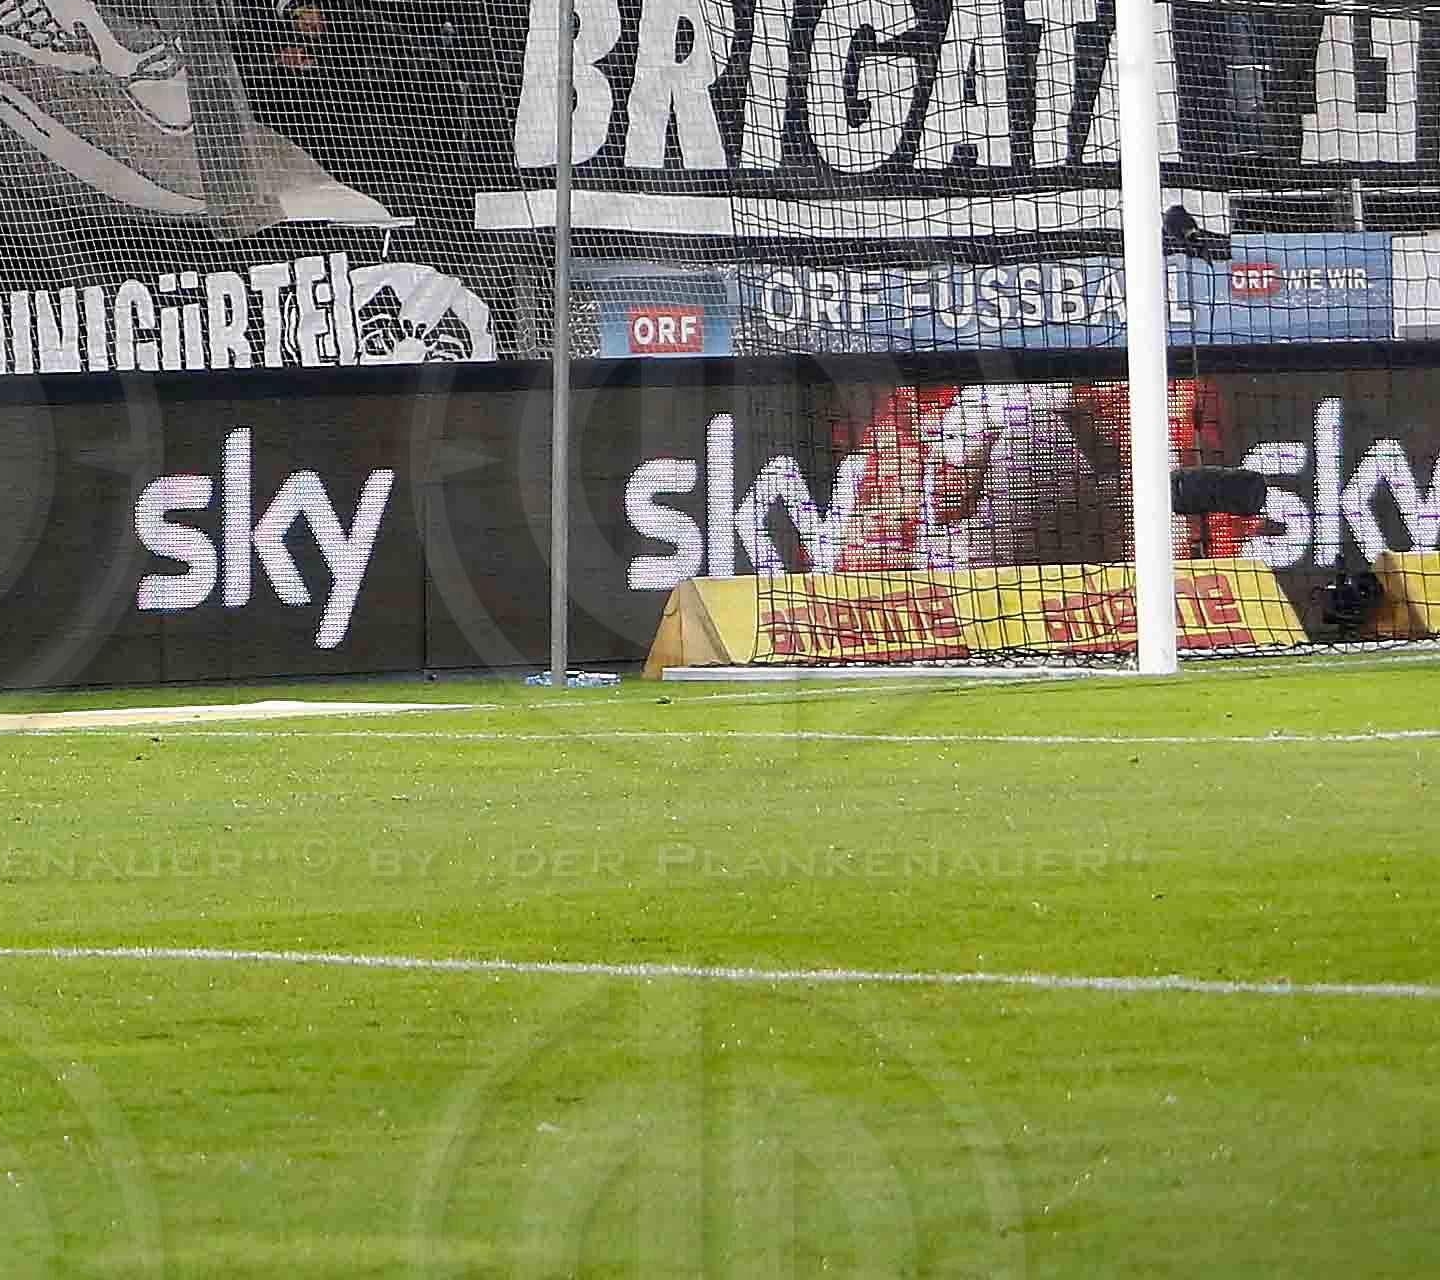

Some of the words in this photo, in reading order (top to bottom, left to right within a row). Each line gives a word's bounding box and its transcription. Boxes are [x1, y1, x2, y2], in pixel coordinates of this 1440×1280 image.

[762, 264, 884, 332] ORF
[902, 258, 1196, 330] FUSSBAL
[1231, 269, 1274, 290] ORF
[633, 313, 699, 346] ORF
[135, 426, 396, 650] sky
